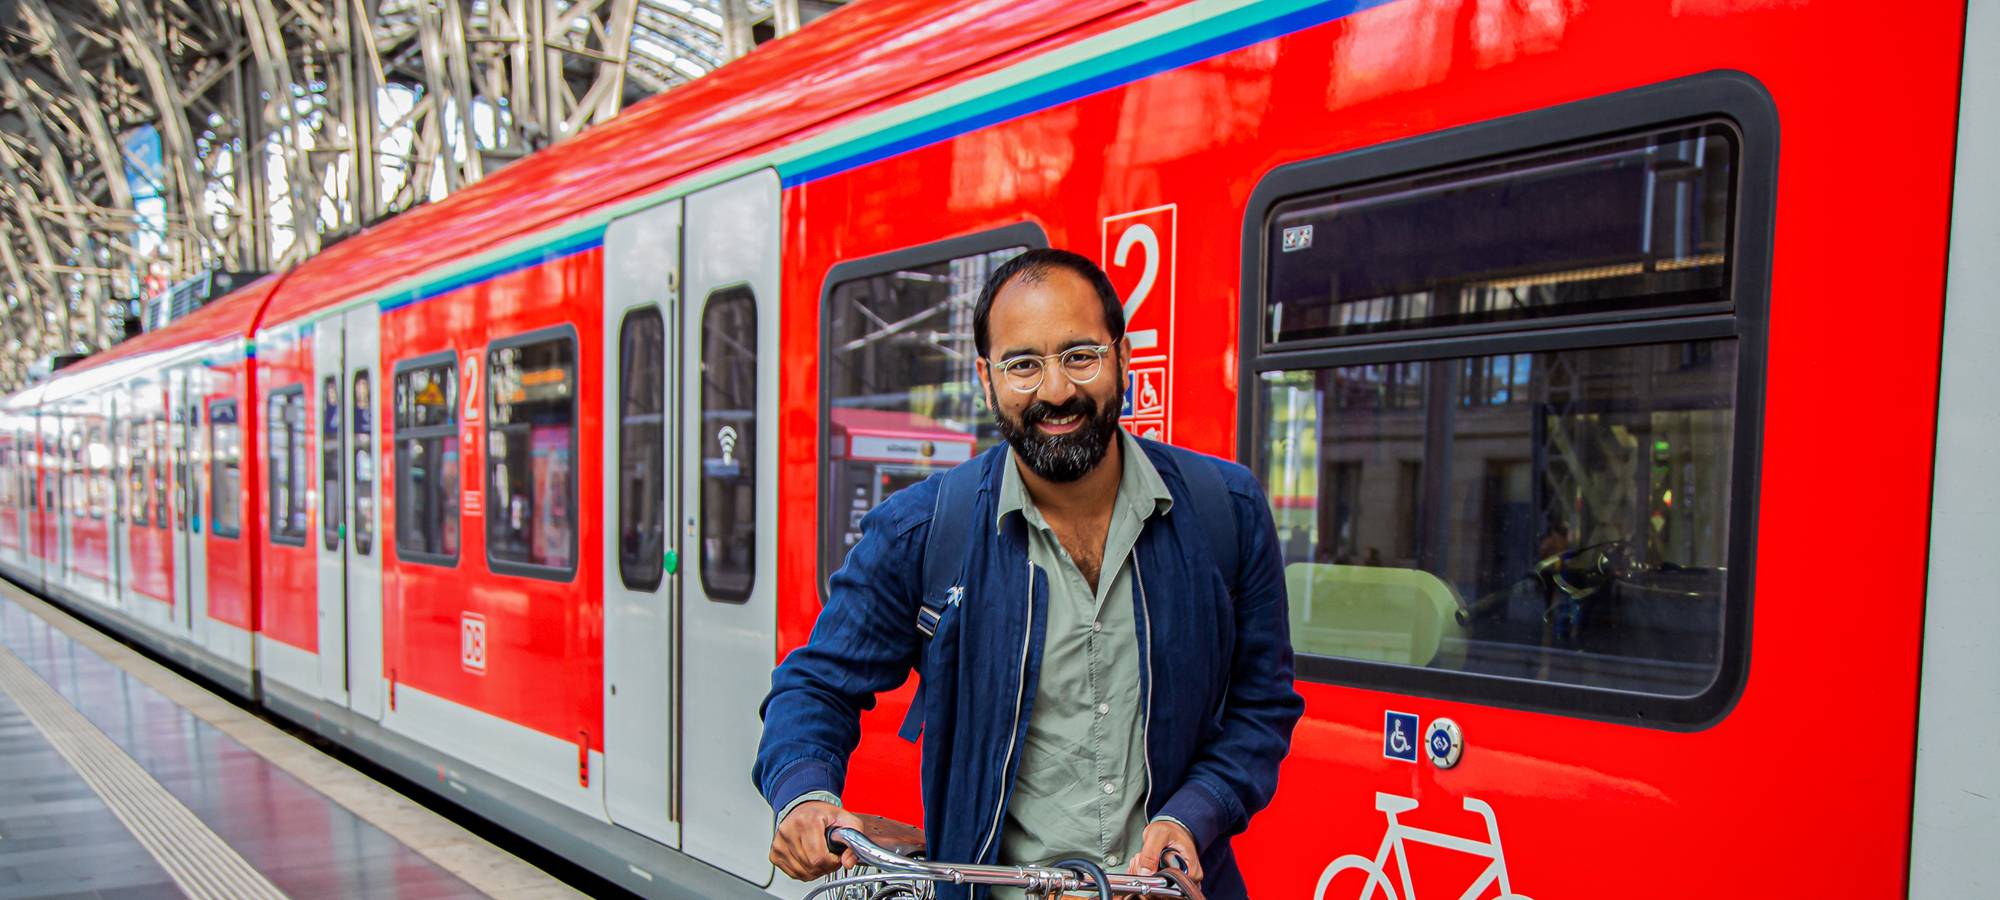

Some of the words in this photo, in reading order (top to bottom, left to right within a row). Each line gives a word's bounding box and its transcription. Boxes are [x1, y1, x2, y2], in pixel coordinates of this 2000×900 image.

[1114, 224, 1159, 348] 2
[464, 357, 479, 419] 2
[463, 620, 484, 666] DB
